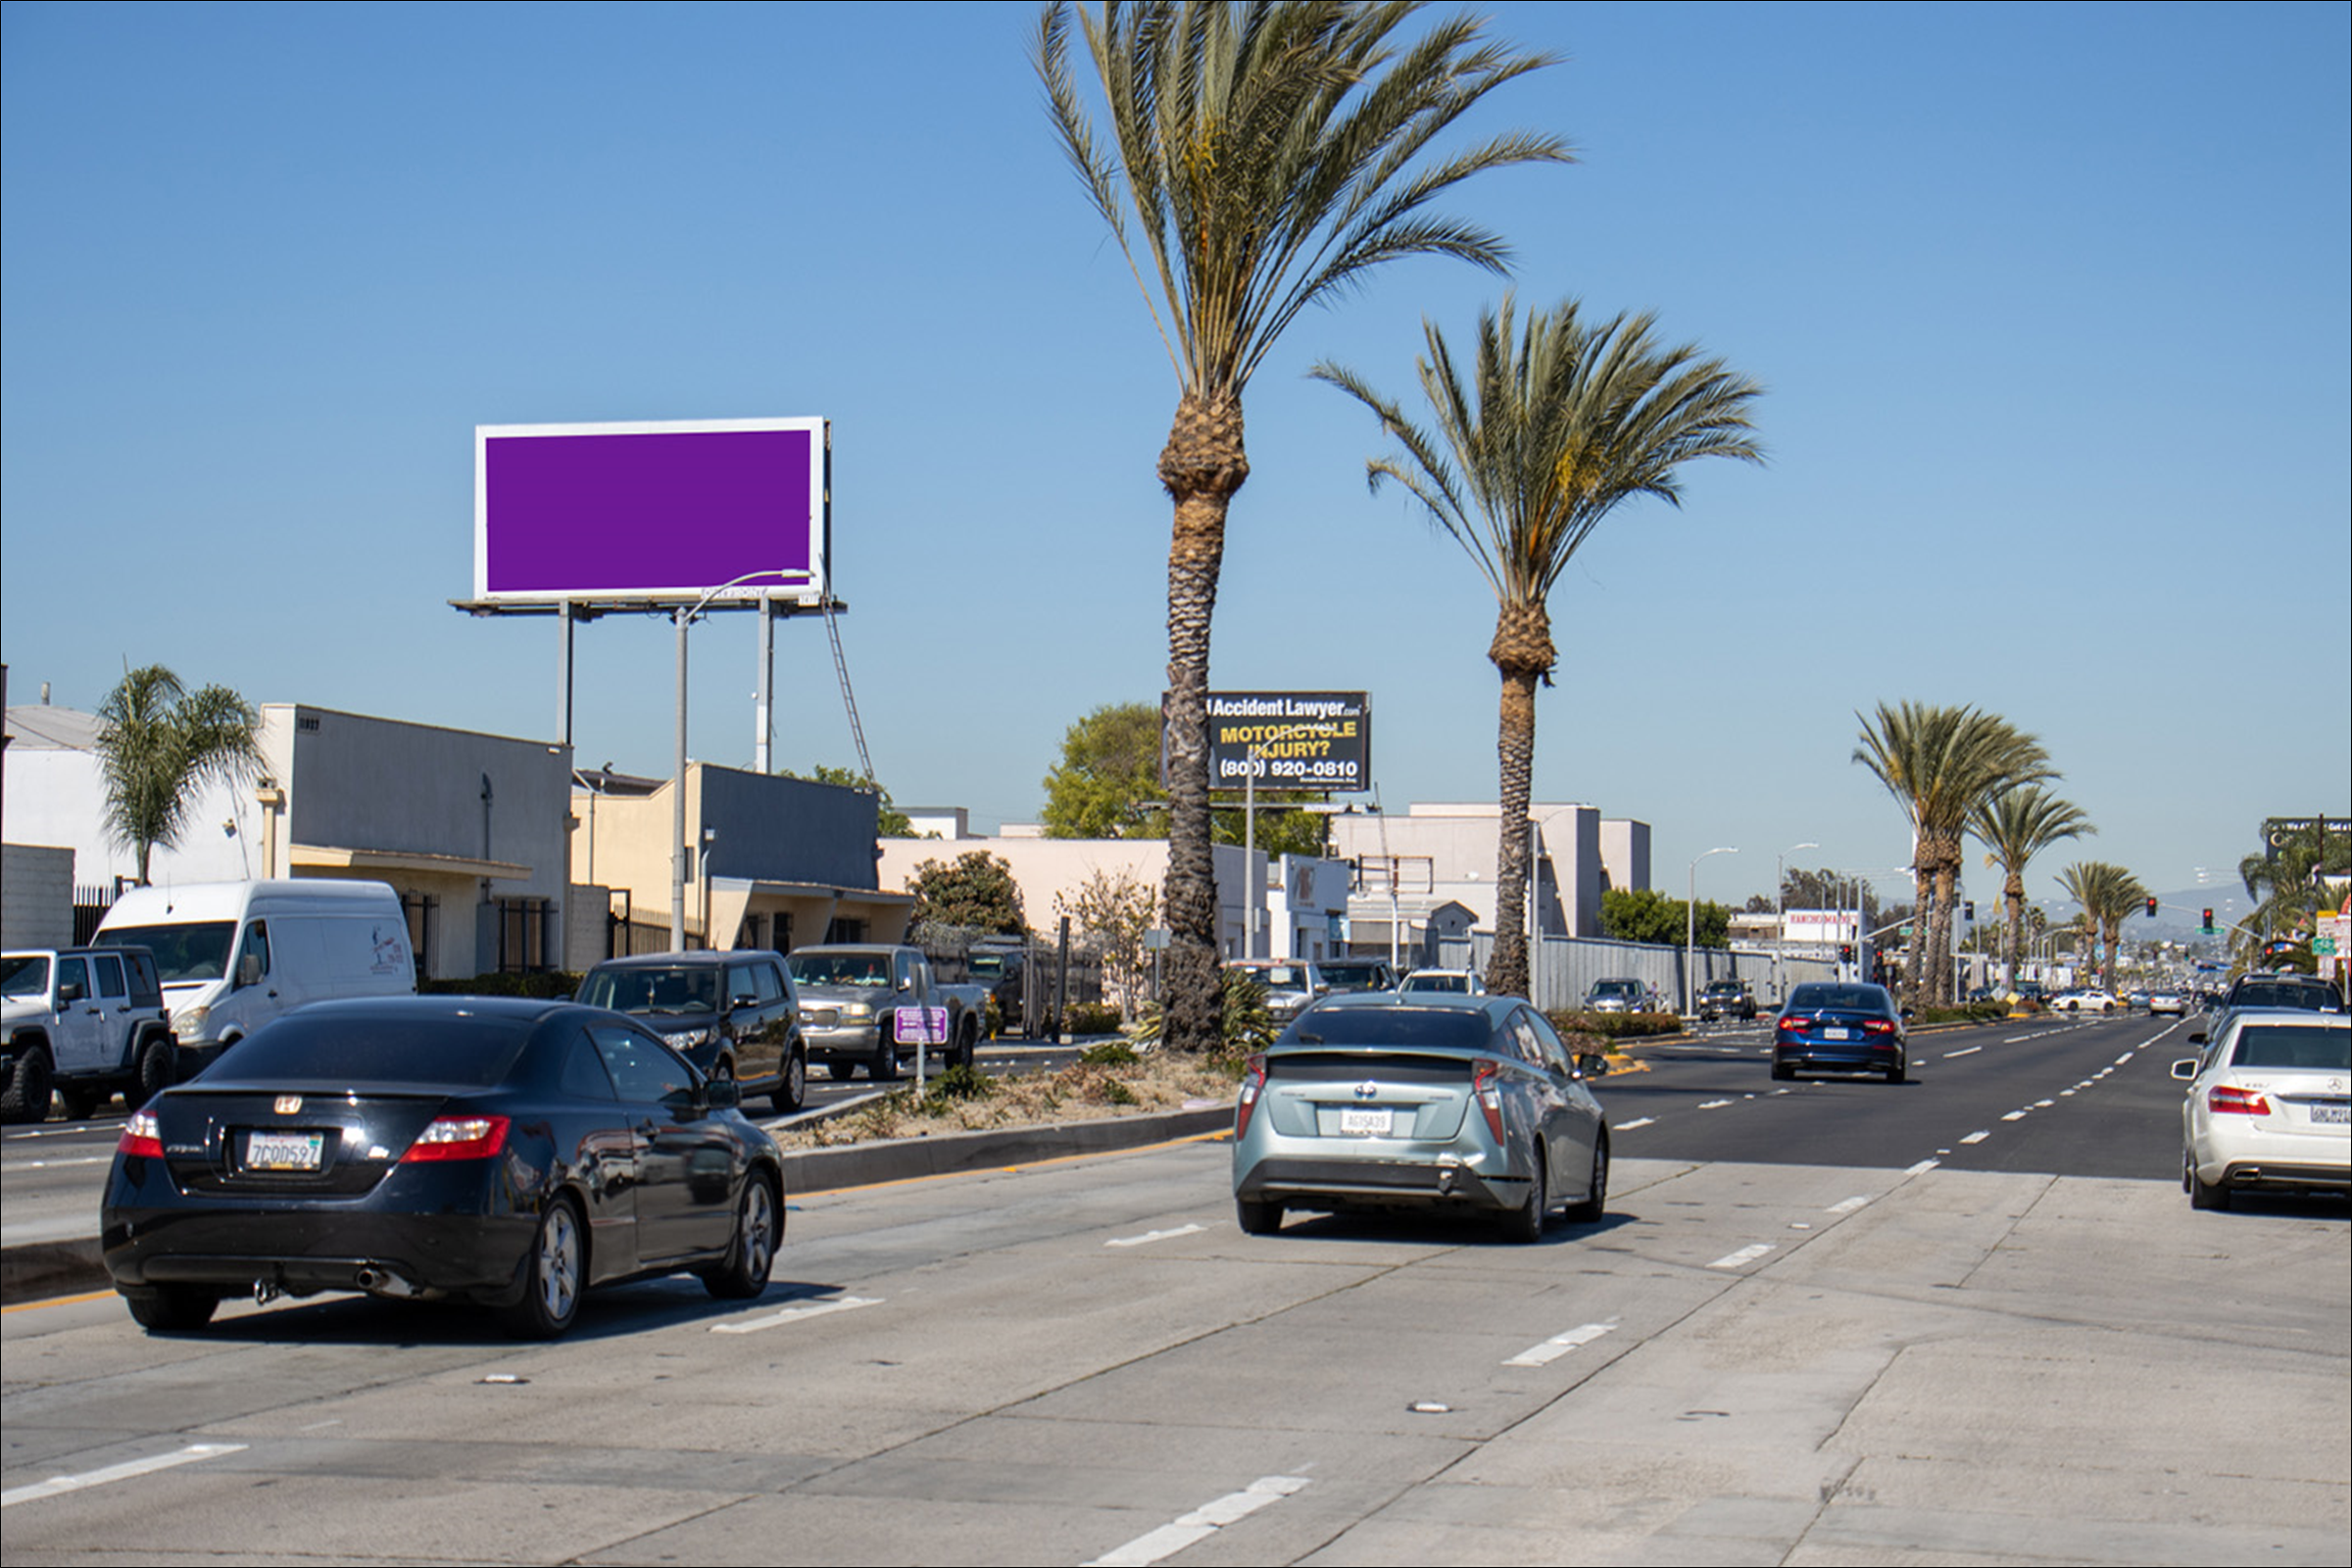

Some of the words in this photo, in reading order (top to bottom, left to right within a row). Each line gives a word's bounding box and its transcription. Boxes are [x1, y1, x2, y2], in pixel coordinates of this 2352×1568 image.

[1212, 698, 1284, 716] Accident
[1220, 721, 1357, 744] MOTORCYCLE
[1220, 759, 1266, 778] (800)
[1271, 760, 1358, 777] 920-0810
